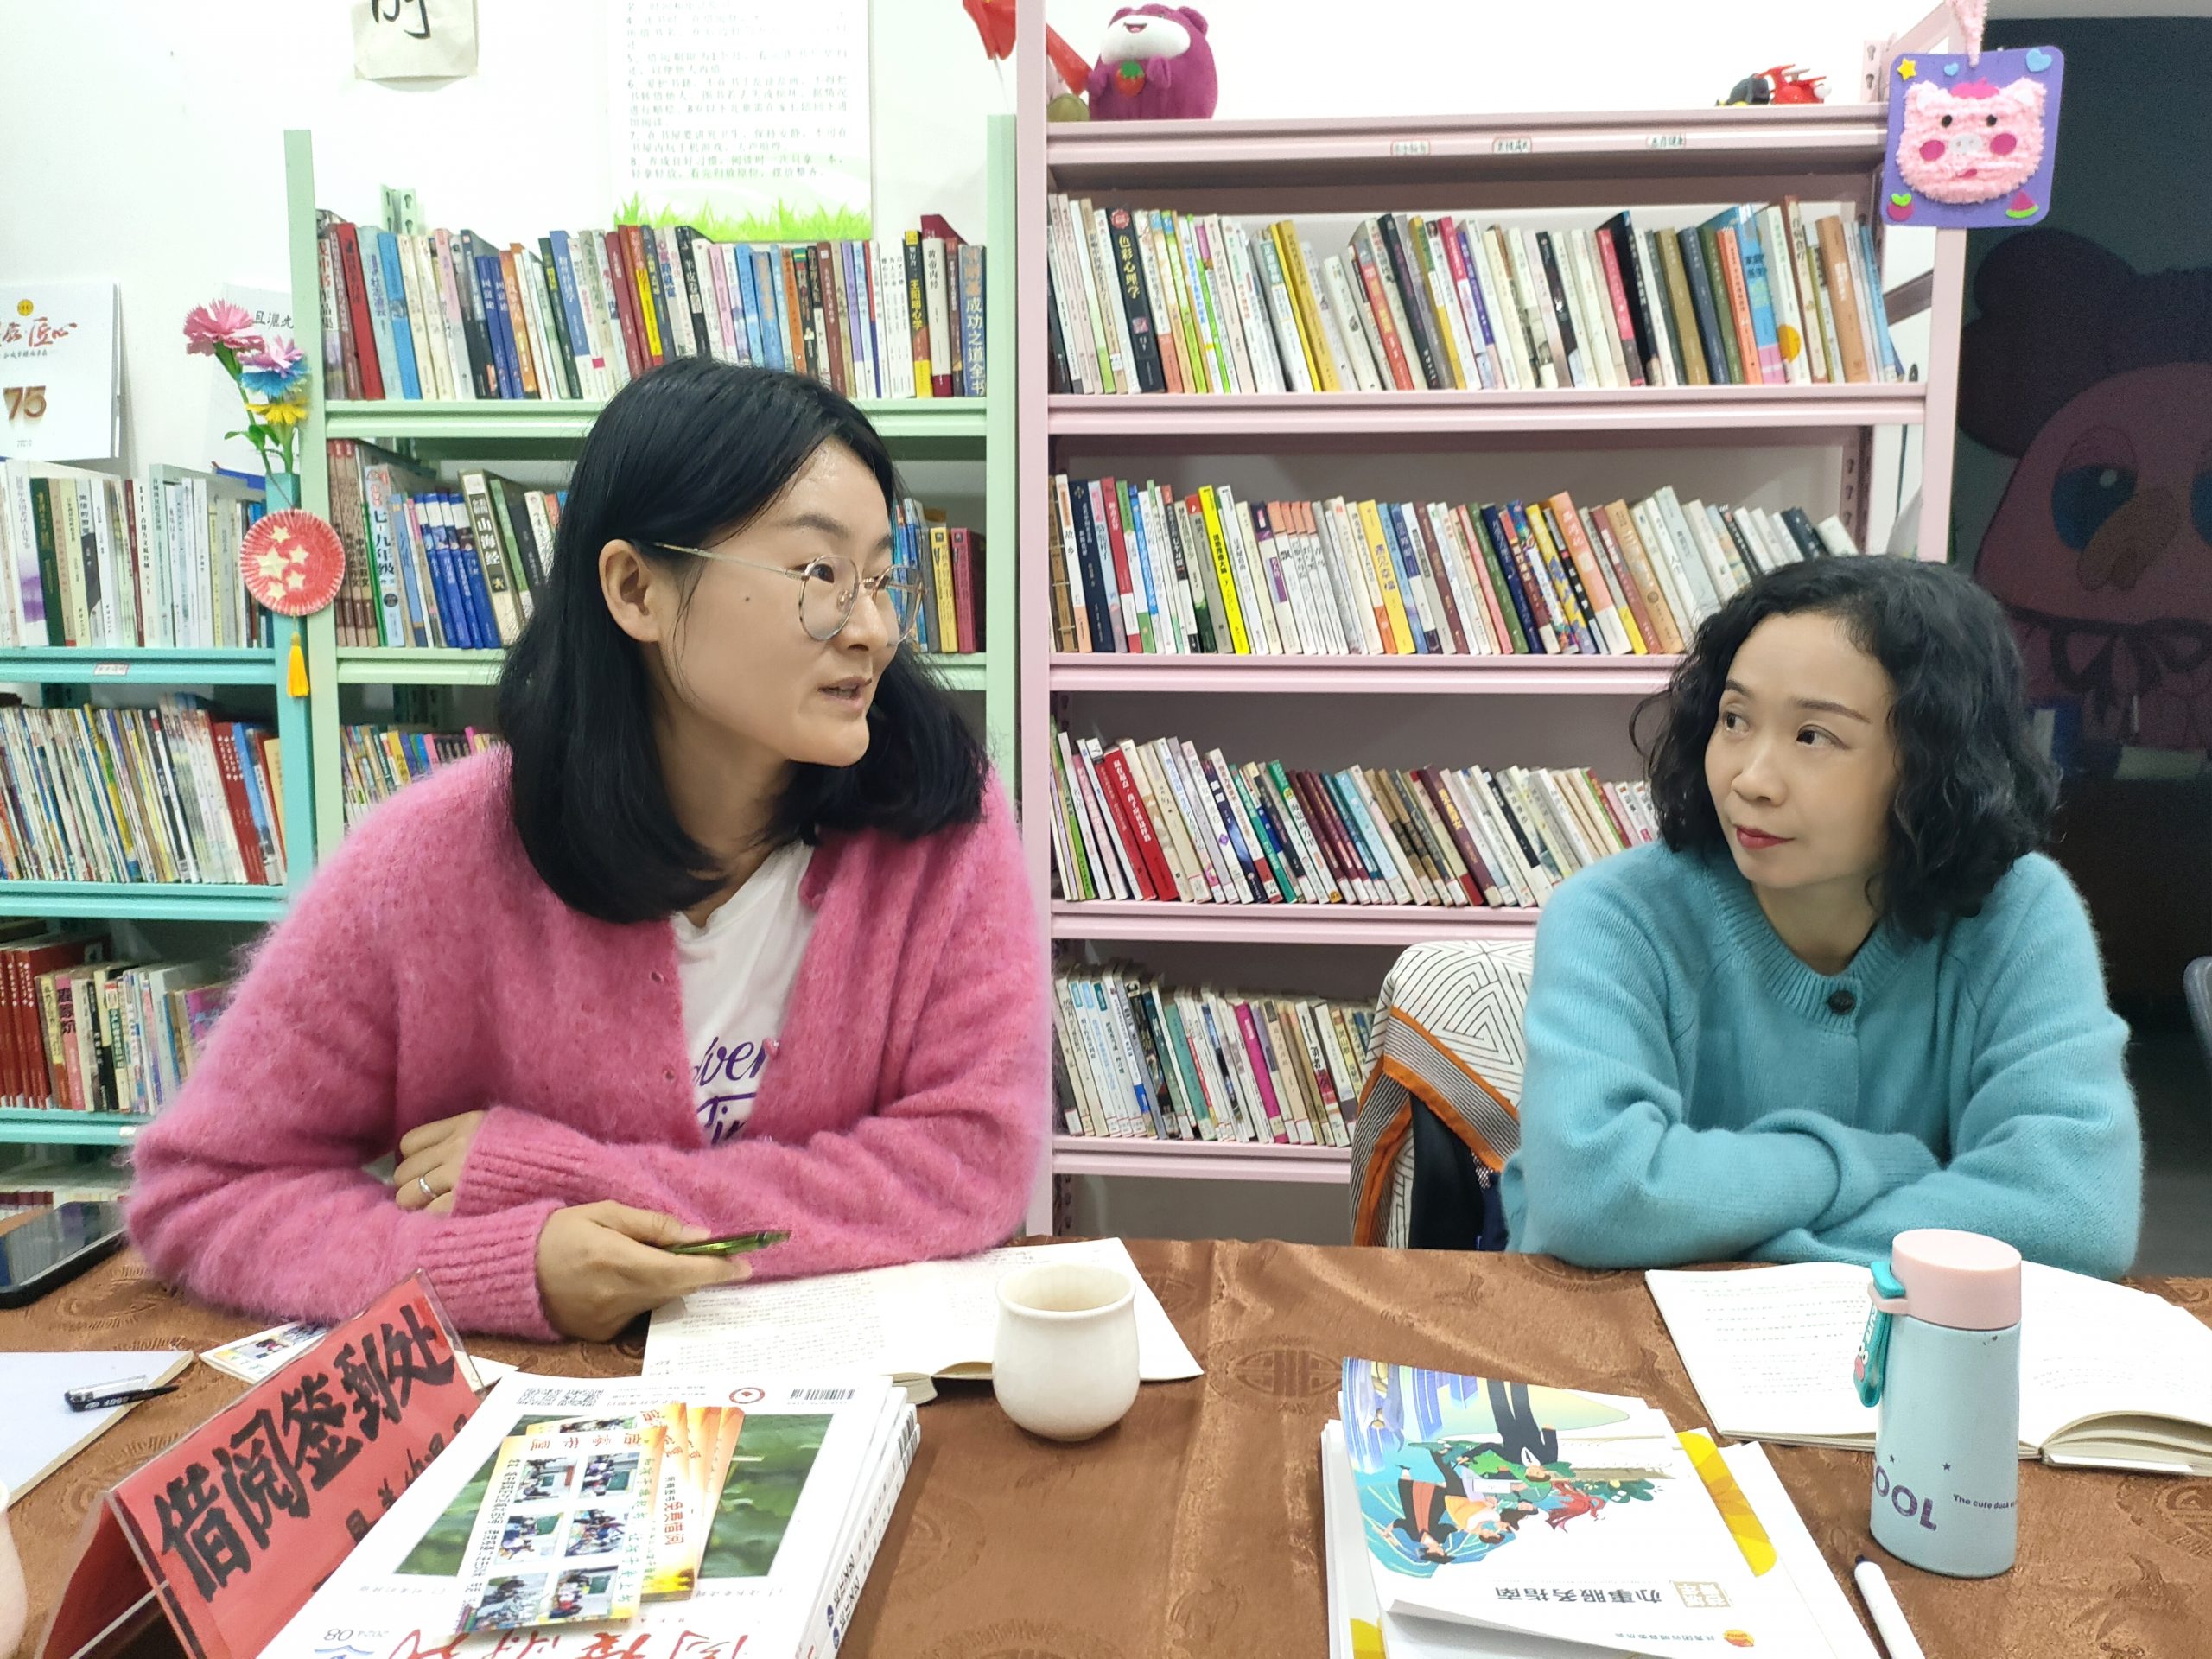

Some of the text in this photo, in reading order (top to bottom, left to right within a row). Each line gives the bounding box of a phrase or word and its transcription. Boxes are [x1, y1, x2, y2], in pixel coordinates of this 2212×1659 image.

[1118, 234, 1141, 300] 色彩心理学
[3, 385, 47, 421] 75
[476, 517, 500, 566] 山海经
[1065, 530, 1075, 556] 故乡
[154, 1305, 455, 1603] 借阅签到处
[1875, 1465, 1937, 1531] OOL
[1953, 1493, 1971, 1506] The
[1973, 1500, 1993, 1510] cute
[1496, 1586, 1662, 1605] 办事服务指南
[323, 1629, 354, 1642] 08
